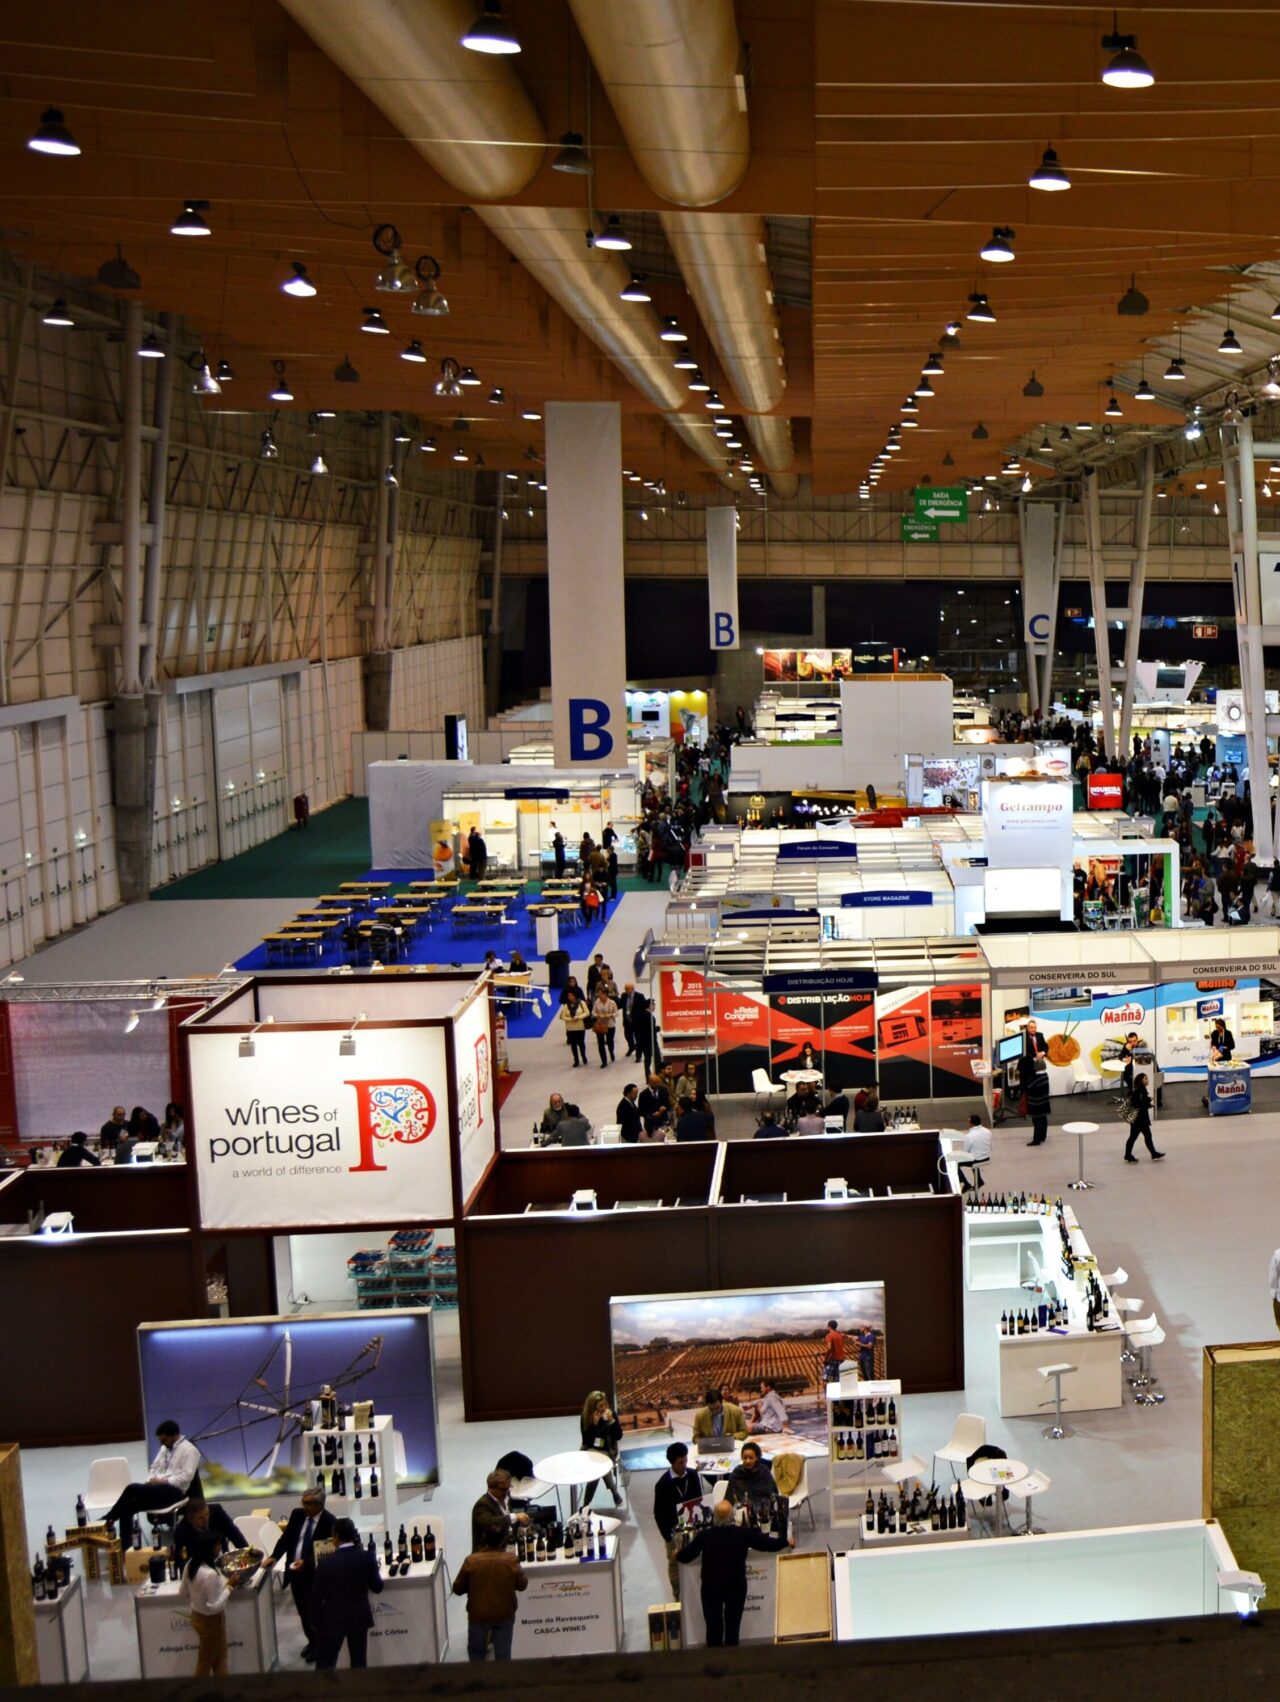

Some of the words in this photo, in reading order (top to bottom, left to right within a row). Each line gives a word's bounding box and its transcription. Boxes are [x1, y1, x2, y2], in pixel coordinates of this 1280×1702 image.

[928, 498, 963, 506] EMERGÊNCIA
[714, 612, 735, 646] B
[1028, 614, 1050, 640] C
[569, 698, 614, 761] B
[1030, 972, 1086, 981] CONSERVEIRA
[1101, 970, 1116, 978] SUL
[1193, 964, 1248, 974] CONSERVEIRA
[1250, 964, 1260, 972] DO
[1104, 1008, 1142, 1024] Manná
[225, 1099, 320, 1126] wines
[324, 1108, 338, 1122] of
[209, 1127, 341, 1162] portugal
[242, 1166, 272, 1178] world
[276, 1165, 286, 1176] of
[289, 1164, 342, 1176] difference
[562, 1624, 586, 1632] WINES
